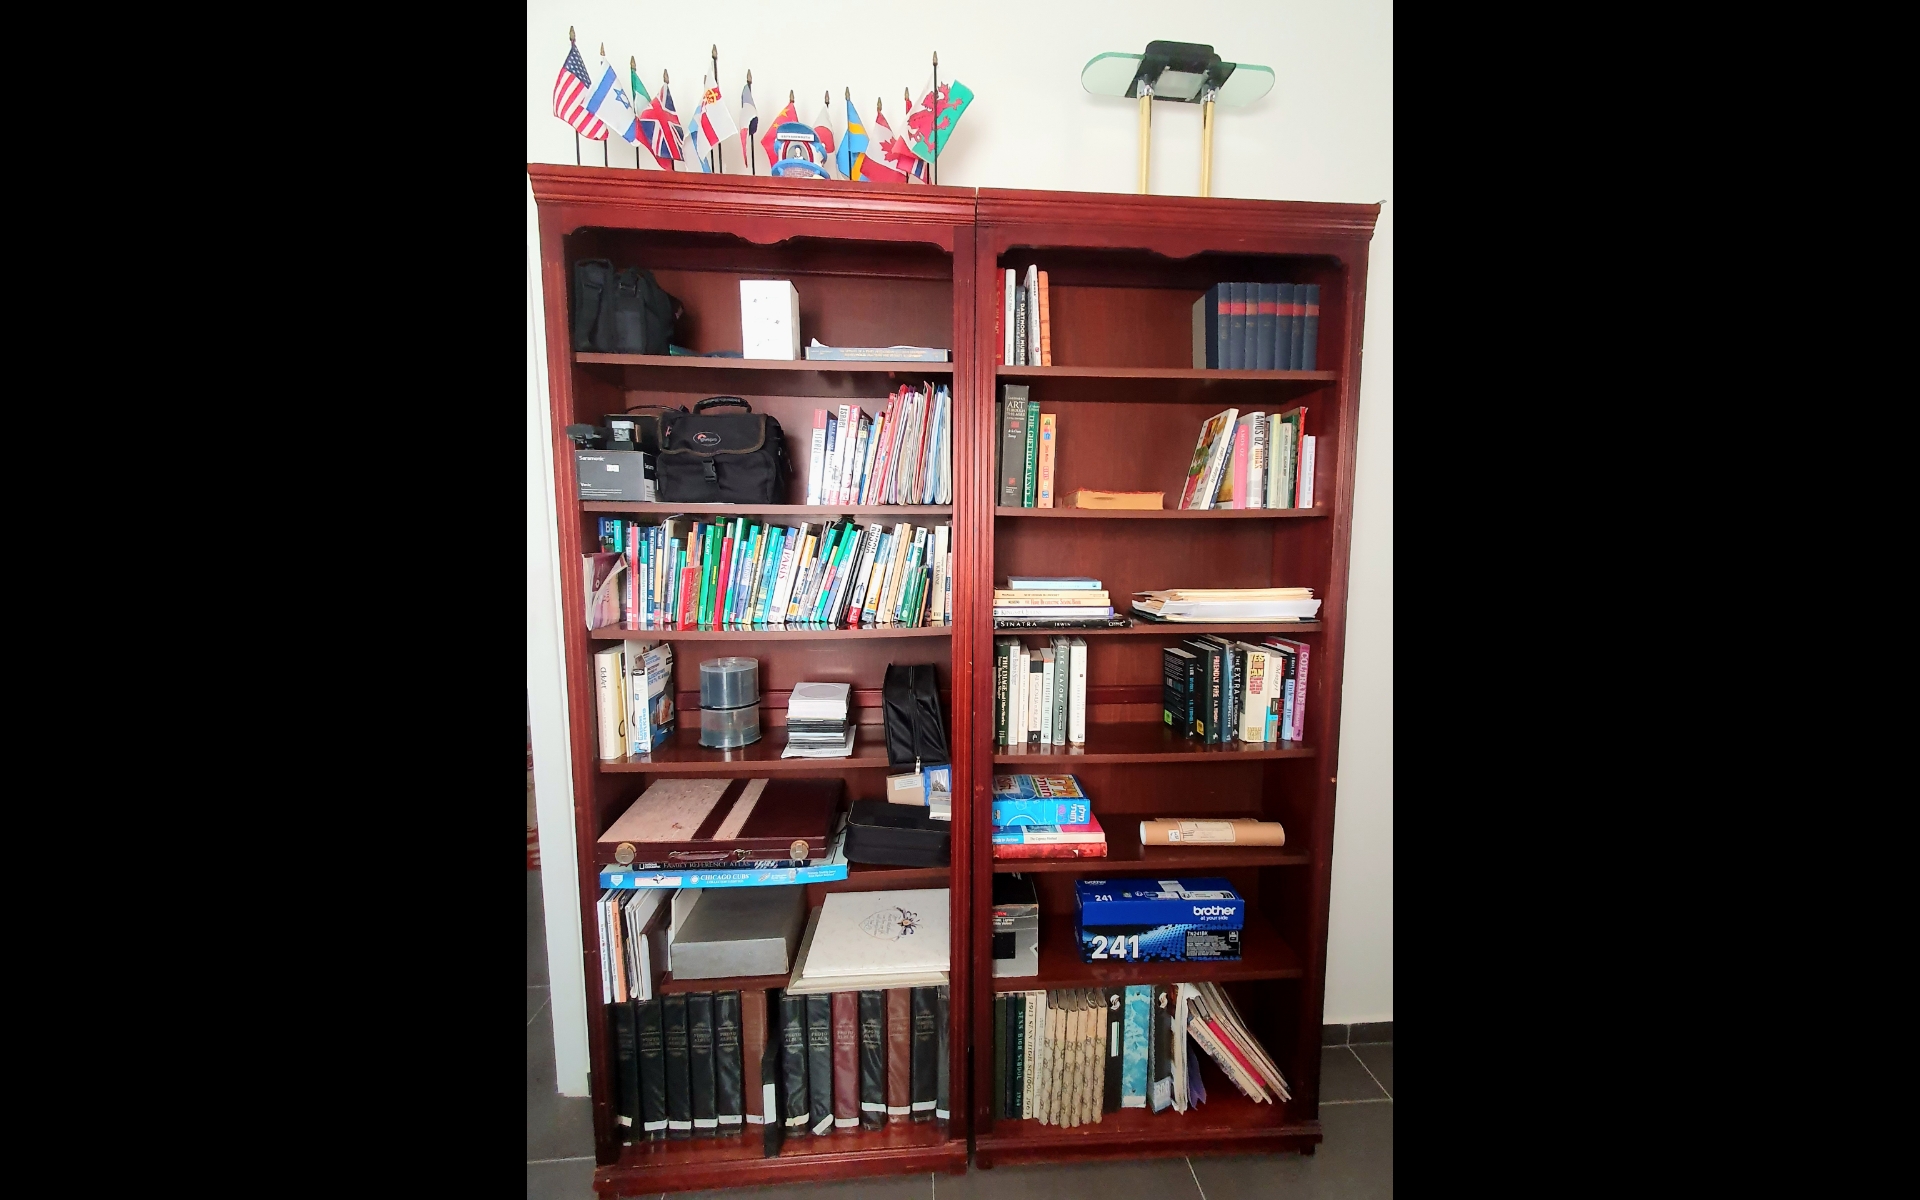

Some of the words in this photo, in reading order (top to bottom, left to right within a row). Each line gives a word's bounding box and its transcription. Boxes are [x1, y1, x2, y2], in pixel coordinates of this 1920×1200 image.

[1007, 401, 1026, 409] ART
[1255, 415, 1264, 435] AMOS
[1255, 436, 1264, 446] OZ
[778, 551, 790, 580] PARIS
[1212, 655, 1220, 683] FRIENDLY
[1297, 651, 1309, 705] COLTRANE
[1193, 906, 1236, 916] brother
[1091, 935, 1139, 959] 241
